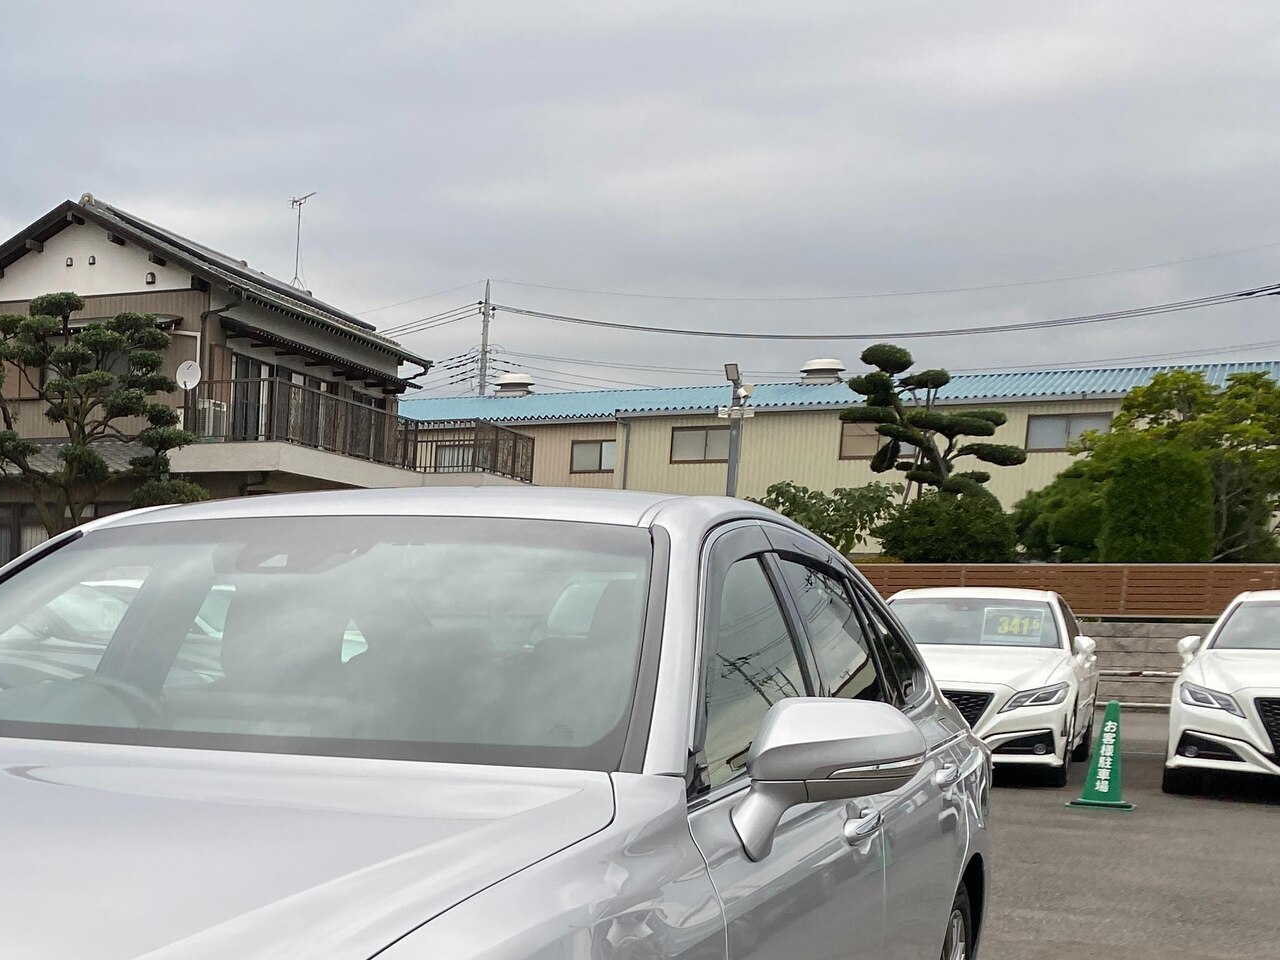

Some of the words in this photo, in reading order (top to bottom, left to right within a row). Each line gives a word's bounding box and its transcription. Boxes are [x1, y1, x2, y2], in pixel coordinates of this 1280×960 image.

[1094, 720, 1118, 793] お客様駐車場
